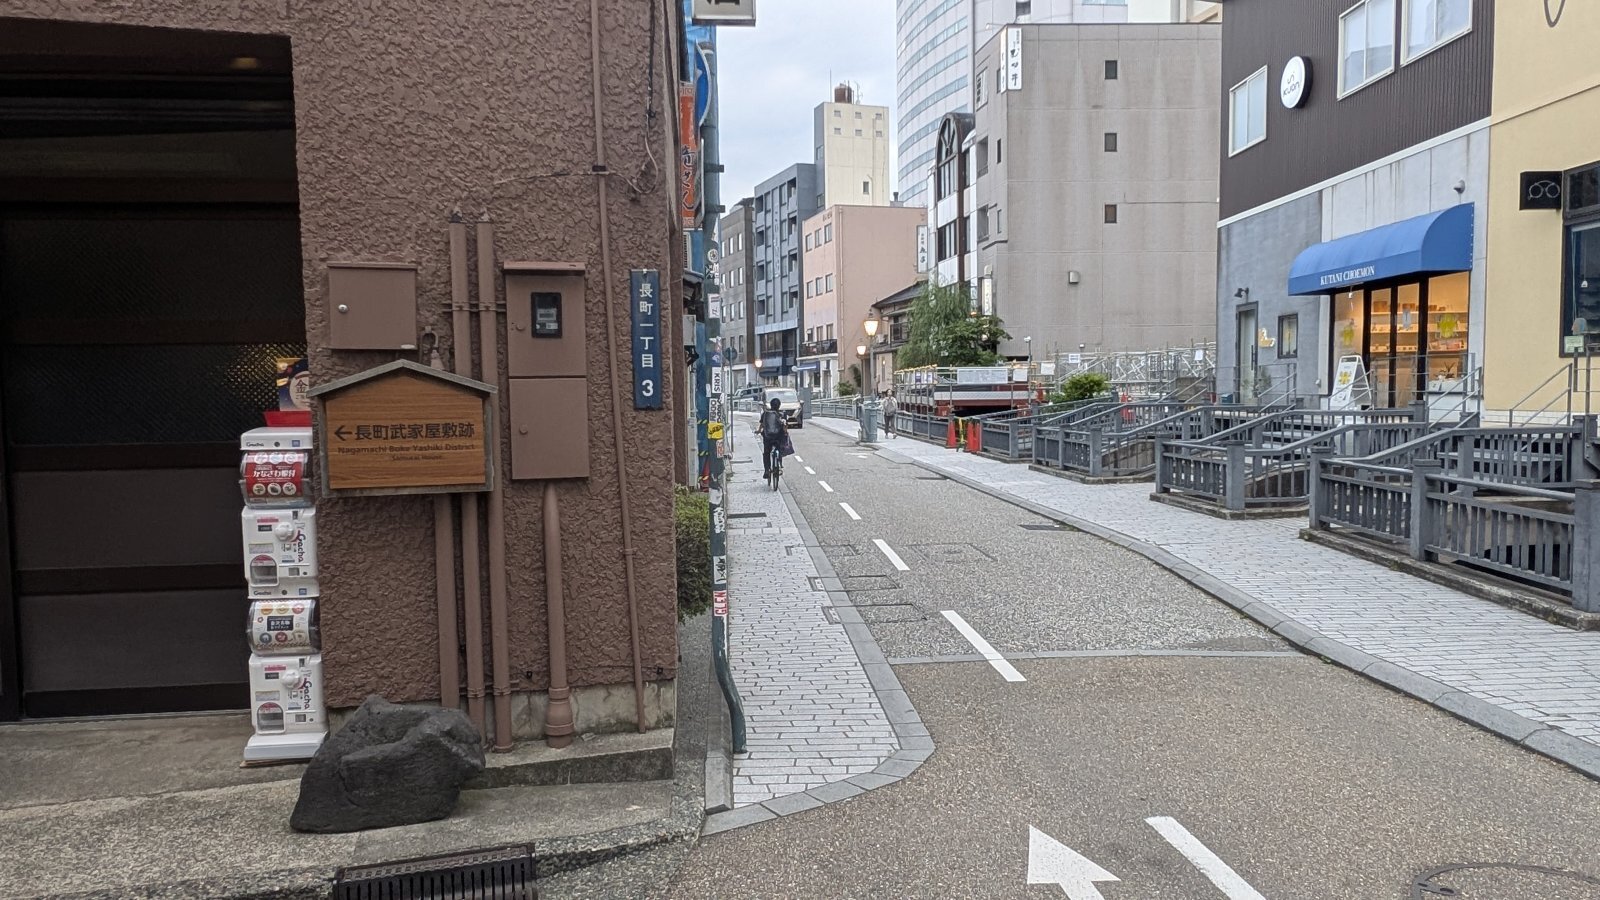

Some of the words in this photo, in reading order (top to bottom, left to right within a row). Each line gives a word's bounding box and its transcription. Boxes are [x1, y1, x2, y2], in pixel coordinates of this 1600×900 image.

[1320, 272, 1343, 286] KUTANI
[1343, 265, 1375, 281] CHOEMON
[641, 379, 654, 397] 3
[713, 372, 721, 392] KRIS
[355, 422, 475, 441] 長町武家屋敷跡
[338, 445, 387, 455] Nagamachi
[412, 444, 443, 452] Yashiki
[445, 443, 475, 451] District
[297, 532, 306, 563] Gacha
[714, 591, 727, 616] GLEN
[303, 679, 312, 710] Gacha
